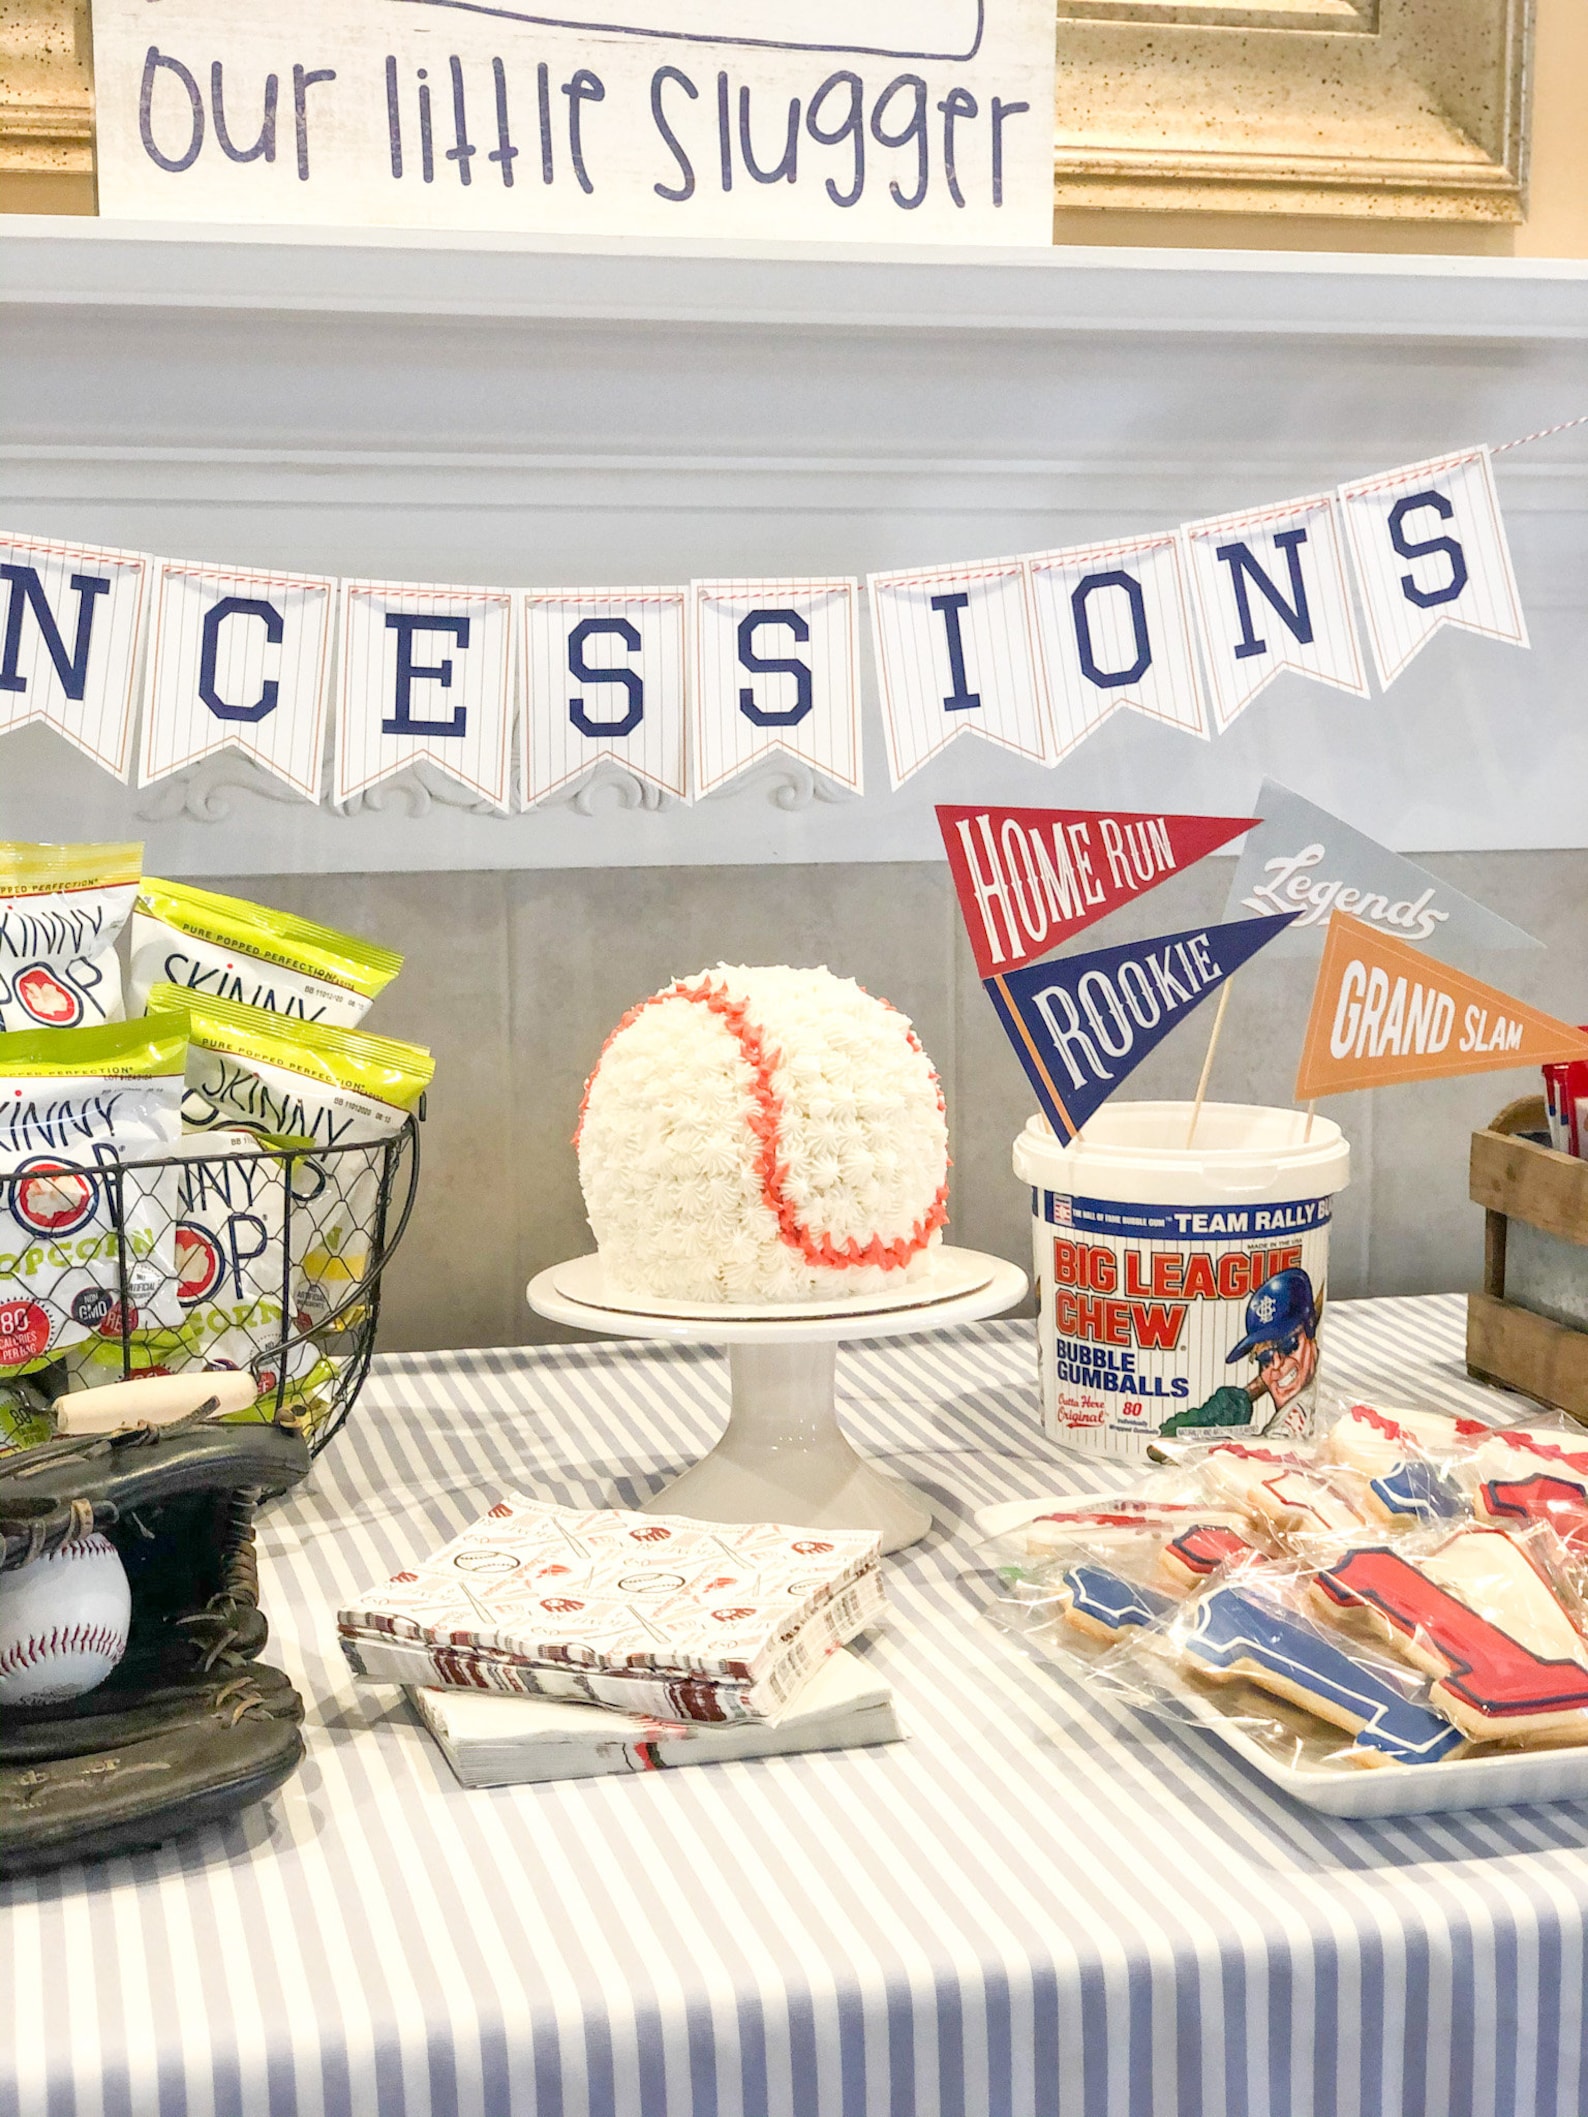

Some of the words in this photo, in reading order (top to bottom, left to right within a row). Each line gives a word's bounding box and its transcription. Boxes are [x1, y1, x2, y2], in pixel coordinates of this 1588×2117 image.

[385, 54, 607, 195] little
[955, 813, 1107, 964] HOME
[1104, 817, 1176, 891] RUN
[1243, 843, 1449, 939] Legends
[183, 923, 212, 940] PURE
[217, 934, 260, 955] POPPED
[1032, 932, 1223, 1091] ROOKIE
[1330, 960, 1456, 1060] GRAND
[1459, 1004, 1523, 1052] SLAM
[202, 1038, 233, 1051] PURE
[238, 1047, 284, 1066] POPPED
[289, 1062, 361, 1089] PERFECION
[1174, 1212, 1249, 1233] TEAM
[1255, 1202, 1316, 1231] RALLY
[1053, 1236, 1117, 1294] BIG
[79, 1301, 107, 1321] GMO
[83, 1293, 99, 1303] NON
[1, 1308, 29, 1335] 80
[1055, 1288, 1189, 1351] CHEW
[3, 1348, 19, 1361] PER
[1056, 1338, 1136, 1374] BUBBLE
[1057, 1361, 1190, 1398] GUMBALLS
[9, 1407, 32, 1426] 80
[1057, 1405, 1106, 1424] Original
[1081, 1395, 1105, 1409] Here
[1122, 1401, 1142, 1417] 80
